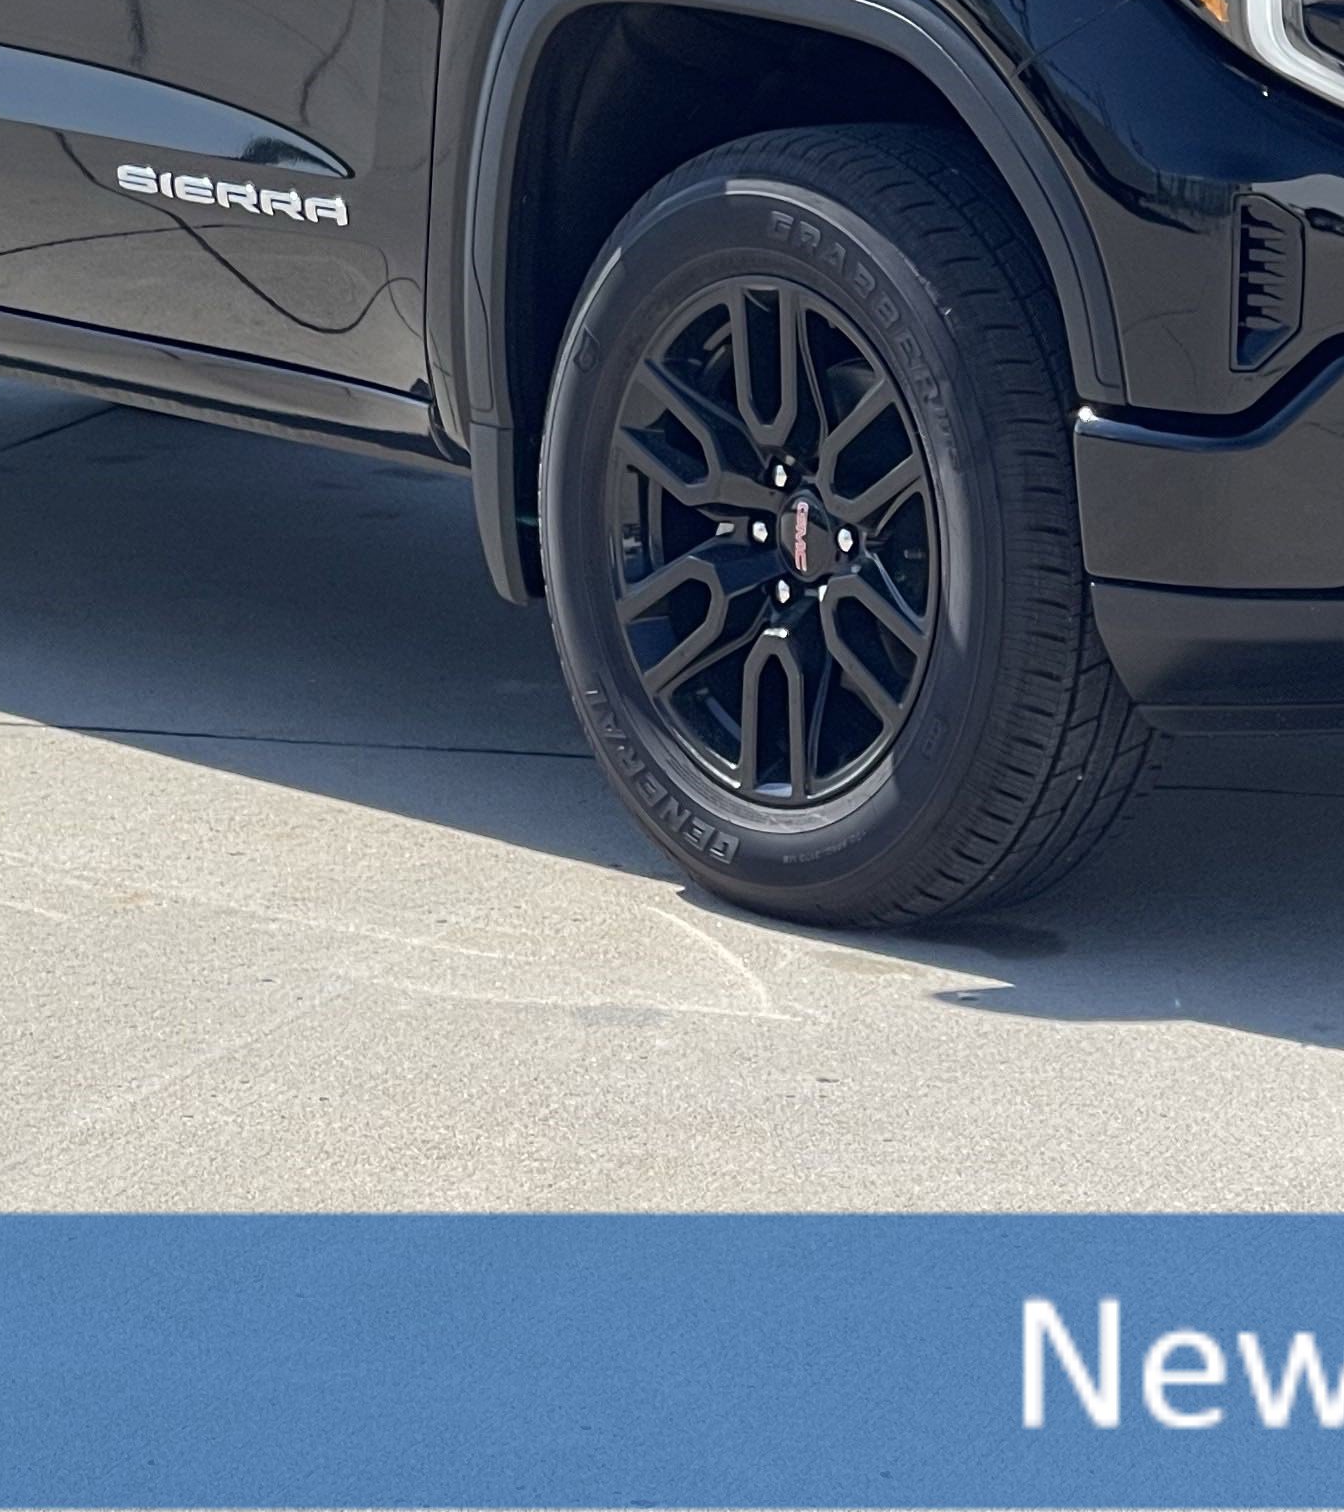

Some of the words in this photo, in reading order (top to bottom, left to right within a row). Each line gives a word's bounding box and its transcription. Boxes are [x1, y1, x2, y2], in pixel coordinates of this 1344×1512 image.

[116, 163, 349, 227] SIERRA
[768, 209, 940, 405] GRABBER
[794, 501, 809, 572] GMC
[584, 689, 741, 866] GENERAL
